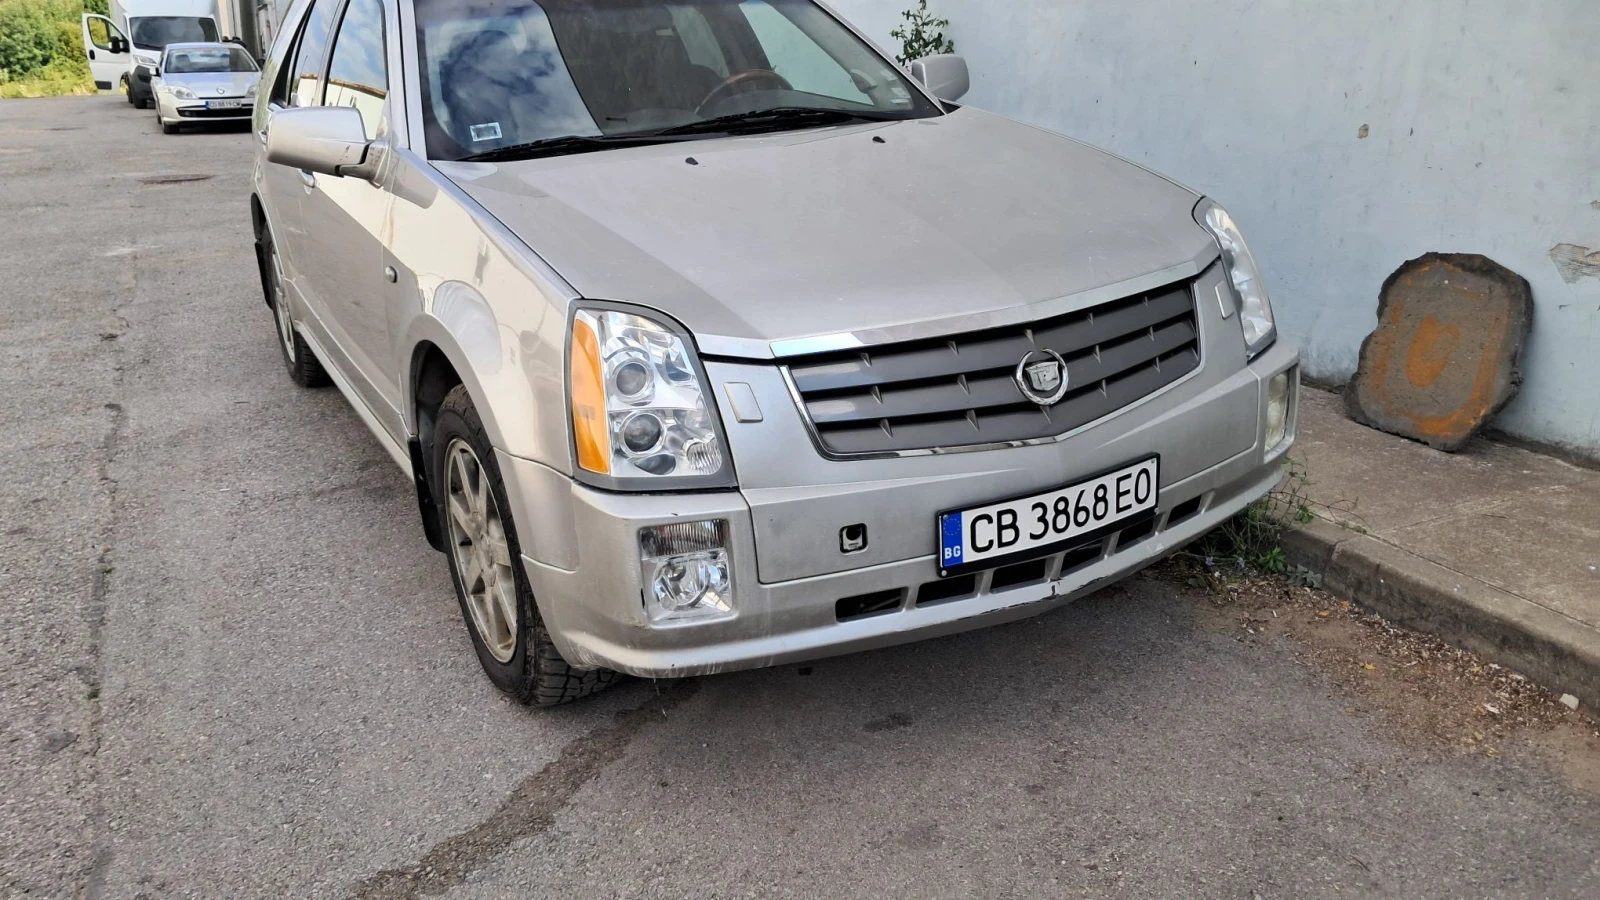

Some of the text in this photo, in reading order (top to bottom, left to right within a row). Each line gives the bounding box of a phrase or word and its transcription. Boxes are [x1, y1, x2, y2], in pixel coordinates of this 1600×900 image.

[970, 508, 1020, 553] CB
[1029, 483, 1108, 540] 3868
[944, 545, 961, 559] BG
